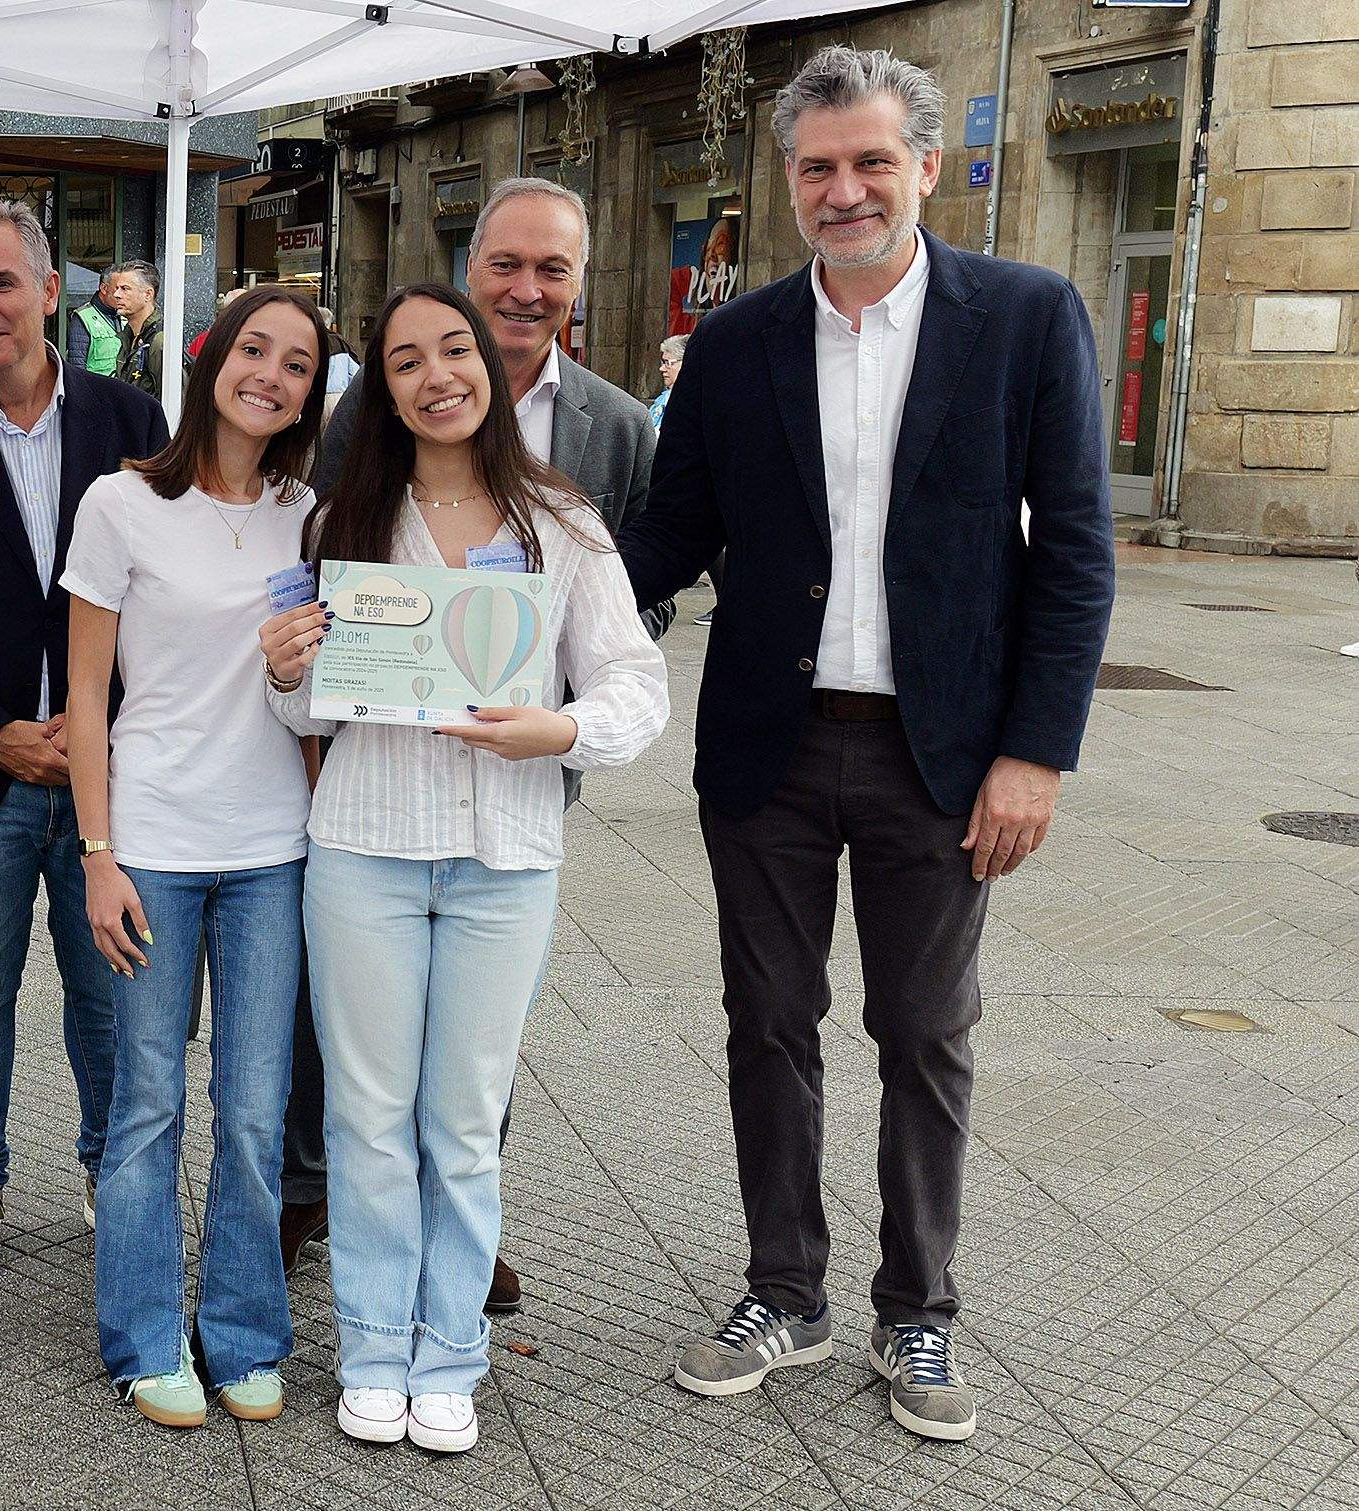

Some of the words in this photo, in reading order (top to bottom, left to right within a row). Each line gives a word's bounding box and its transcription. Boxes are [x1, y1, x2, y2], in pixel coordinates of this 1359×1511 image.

[1071, 92, 1177, 130] Santander
[294, 147, 301, 157] 2
[250, 197, 290, 220] PEDESTAL
[687, 260, 739, 304] PLAY
[354, 593, 419, 609] DEPOEMPRENDE
[353, 605, 365, 617] NA
[367, 607, 384, 618] ESO
[325, 630, 370, 645] DIPLOMA
